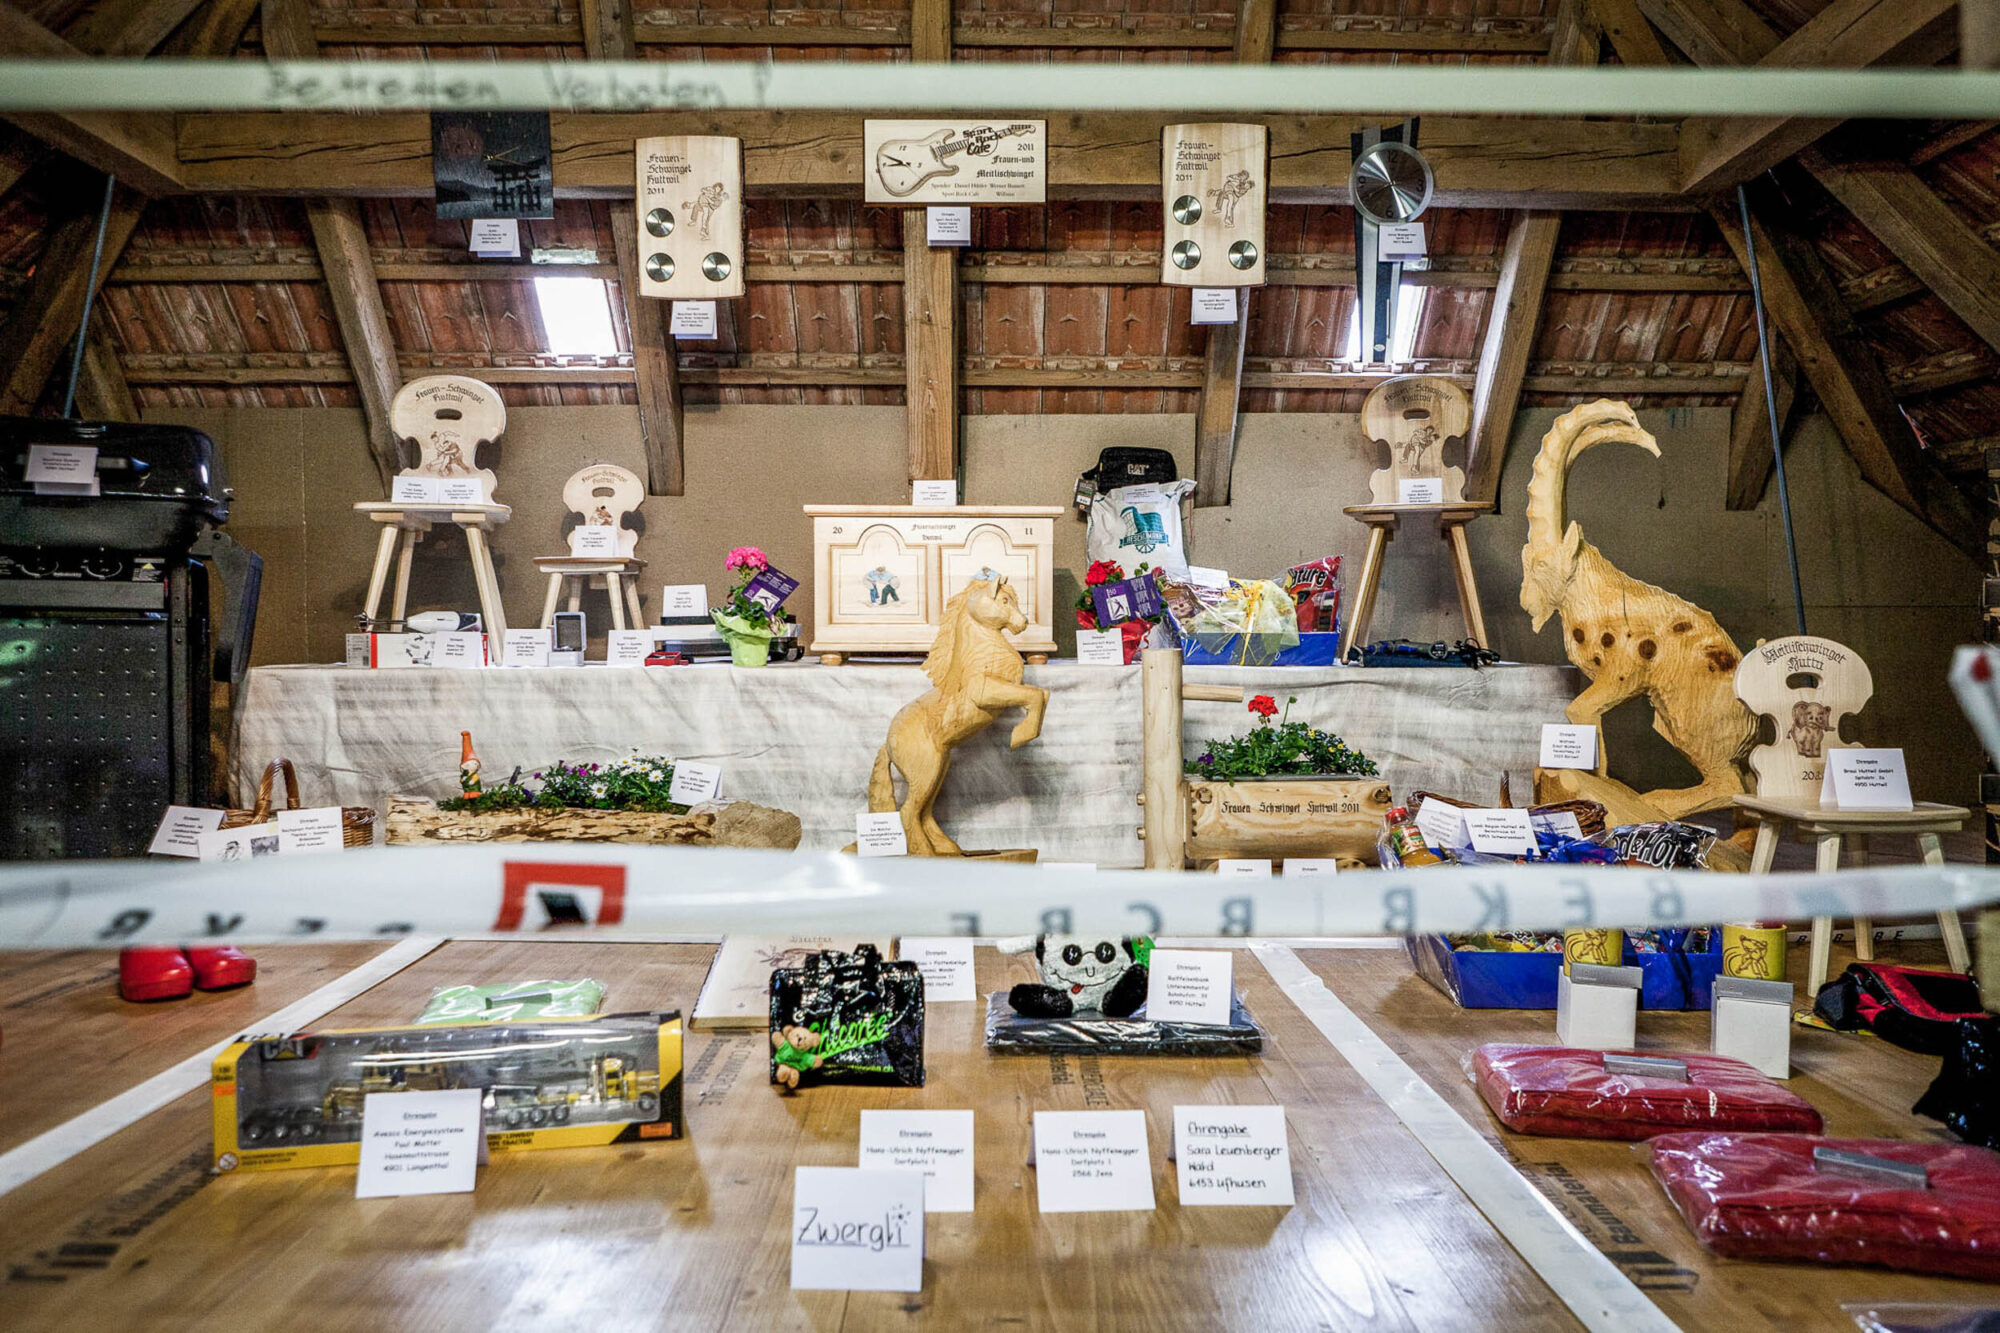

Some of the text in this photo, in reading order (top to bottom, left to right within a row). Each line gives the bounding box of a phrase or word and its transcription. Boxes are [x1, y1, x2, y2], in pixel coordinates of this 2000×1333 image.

[832, 526, 843, 534] 20
[1221, 800, 1360, 816] Frauen Schwinget Huttwil 2011
[1188, 1121, 1249, 1139] Ehrengabe
[1187, 1144, 1283, 1161] Sara Leuenberger
[1217, 1177, 1266, 1193] Ufhusen
[798, 1205, 907, 1252] Zwergli
